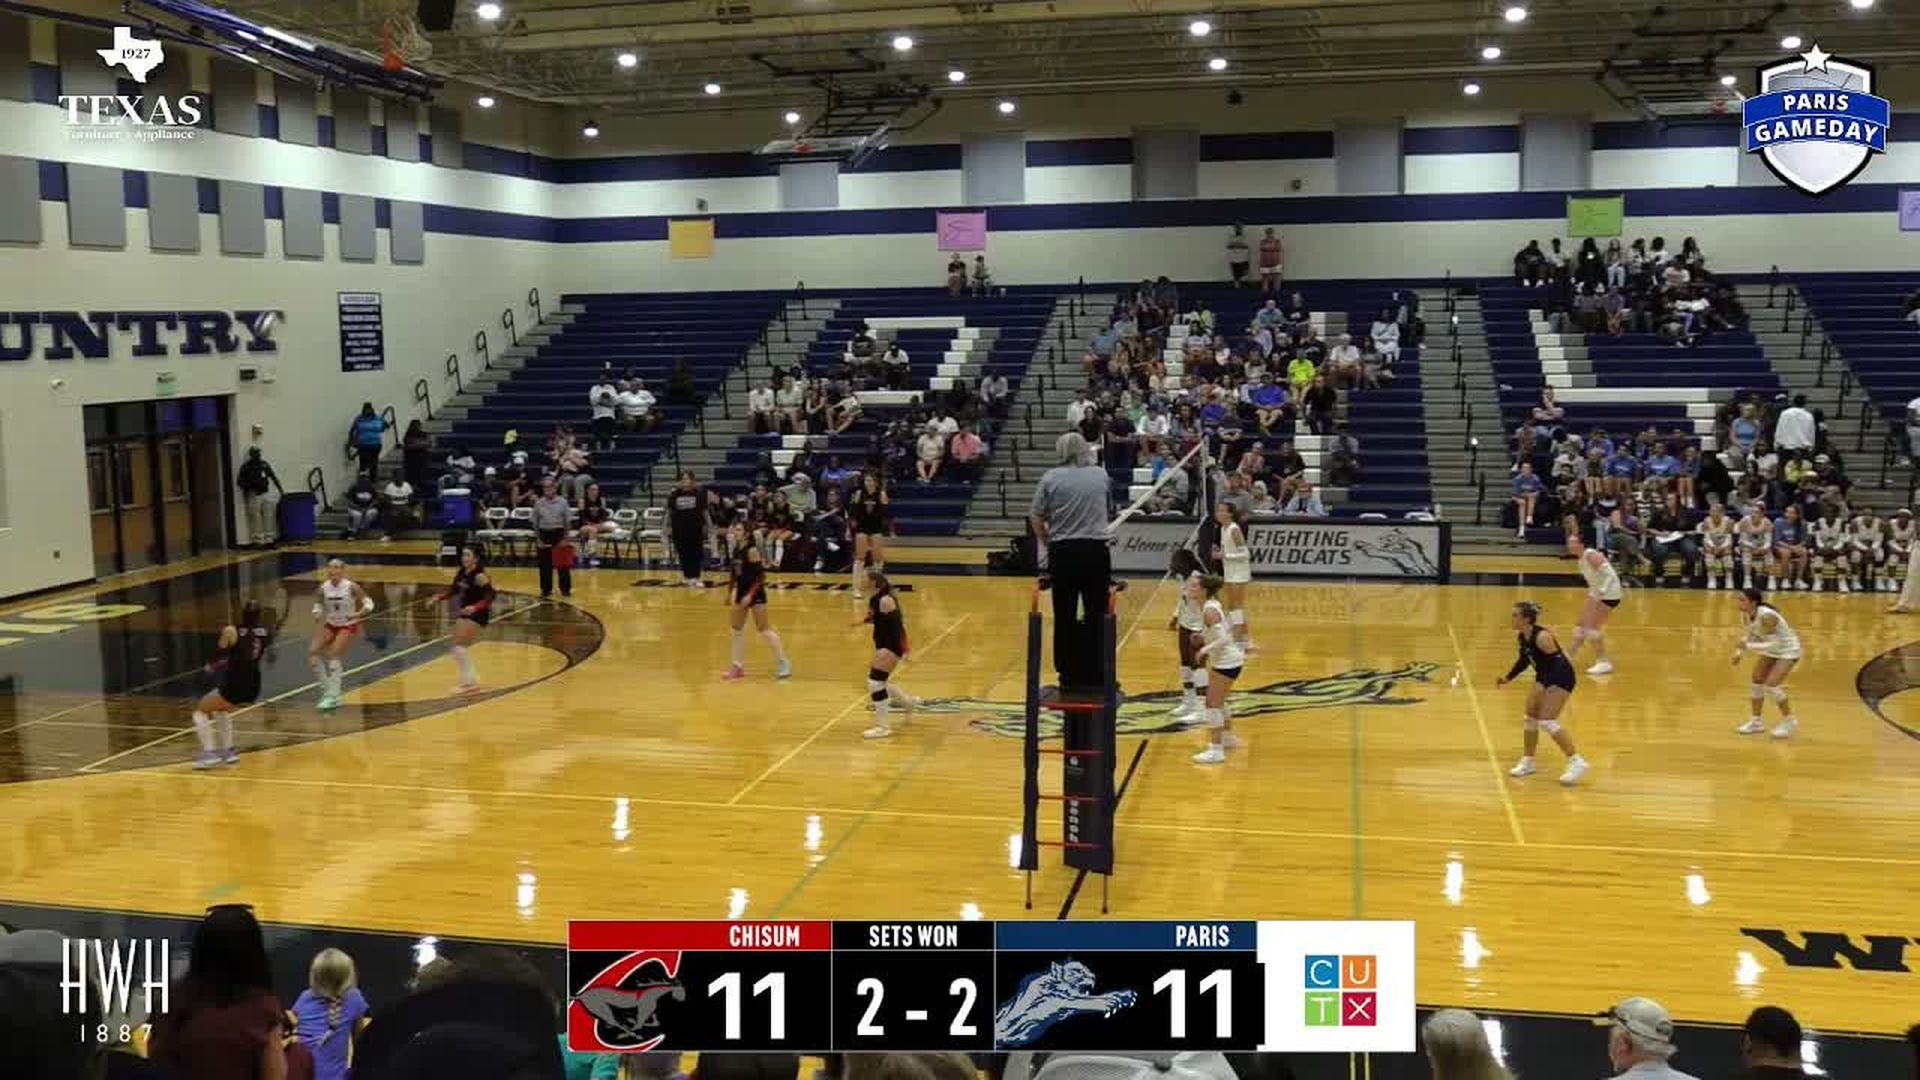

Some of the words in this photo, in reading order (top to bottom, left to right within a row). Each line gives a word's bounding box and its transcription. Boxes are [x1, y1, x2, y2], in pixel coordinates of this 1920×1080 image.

[1252, 530, 1350, 547] FIGHTING
[1249, 548, 1352, 565] WILDCATS
[1740, 927, 1920, 972] W
